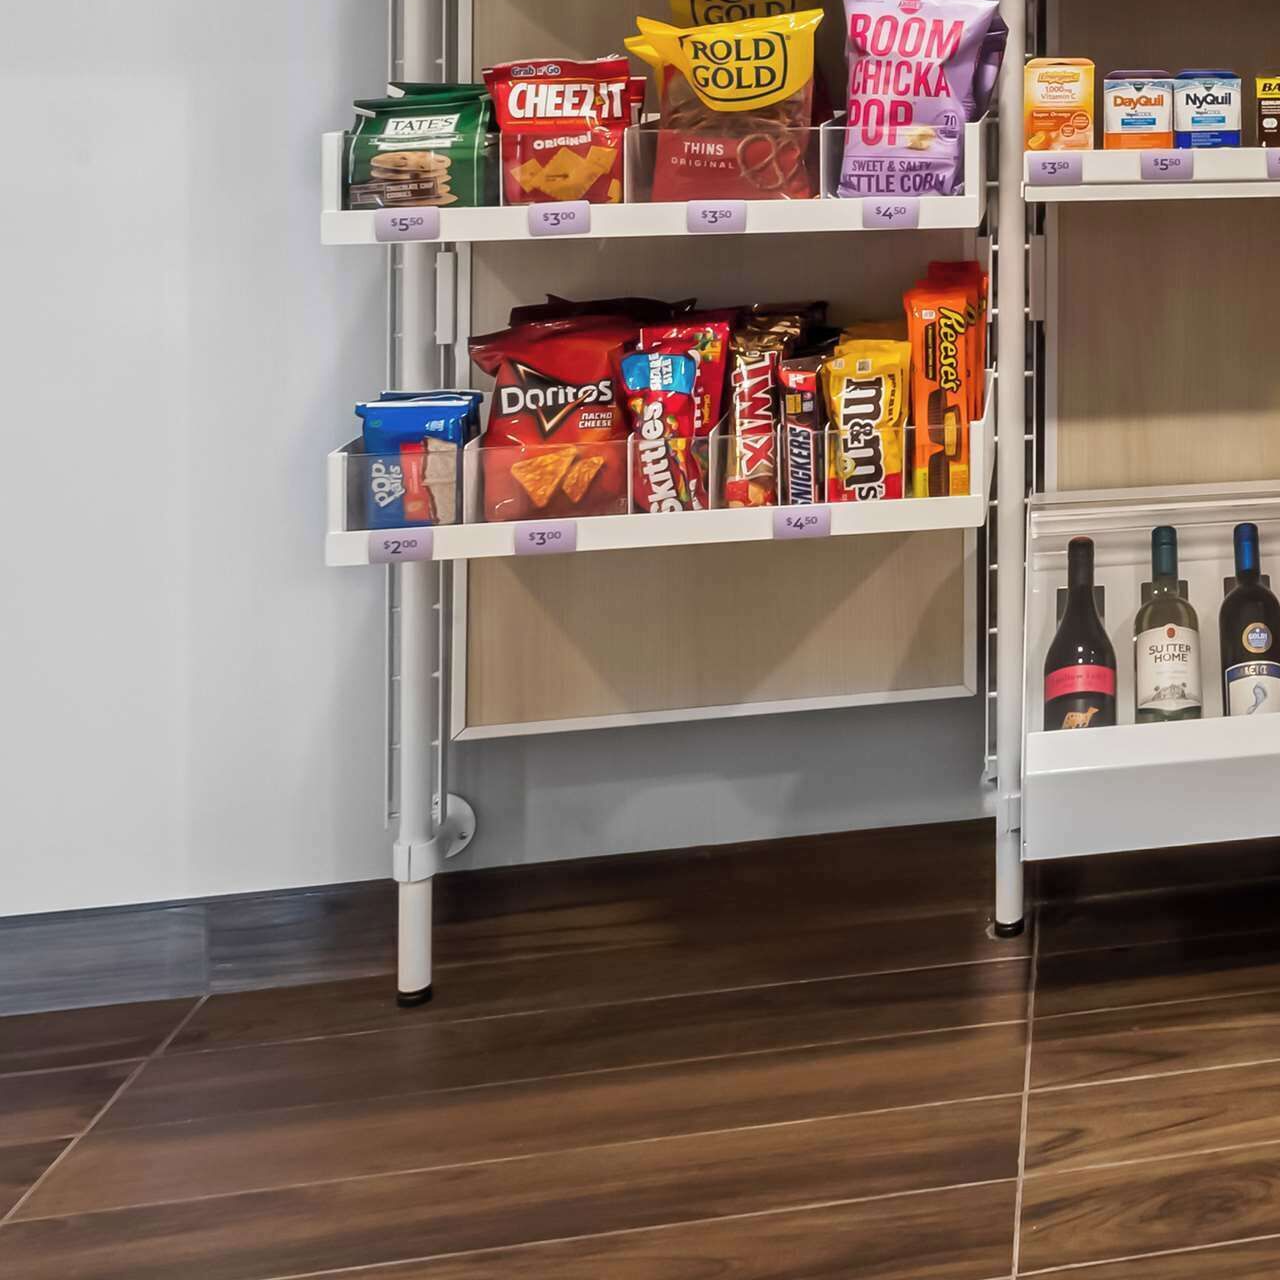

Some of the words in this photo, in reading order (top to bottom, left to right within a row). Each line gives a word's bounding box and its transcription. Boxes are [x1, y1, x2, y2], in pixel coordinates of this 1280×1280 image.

[693, 37, 775, 64] ROLD
[511, 66, 534, 76] Grab
[546, 65, 560, 74] Go
[693, 65, 777, 92] GOLD
[851, 60, 951, 98] CHICKA
[1113, 95, 1165, 109] DayQuil
[1185, 93, 1231, 109] NyQuil
[392, 117, 454, 131] TATE'S
[845, 99, 913, 147] POP
[533, 134, 592, 150] ORIGINAL
[683, 142, 725, 155] THINS
[671, 157, 735, 169] ORIGINAL
[852, 160, 883, 172] SWEET
[887, 160, 895, 171] &
[899, 161, 932, 171] SALTY
[938, 307, 966, 393] Reese's
[501, 380, 613, 415] Doritos
[582, 412, 613, 420] NACHO
[579, 420, 613, 428] CHEESE
[1149, 644, 1191, 656] SUTTER
[1155, 654, 1188, 663] HOME
